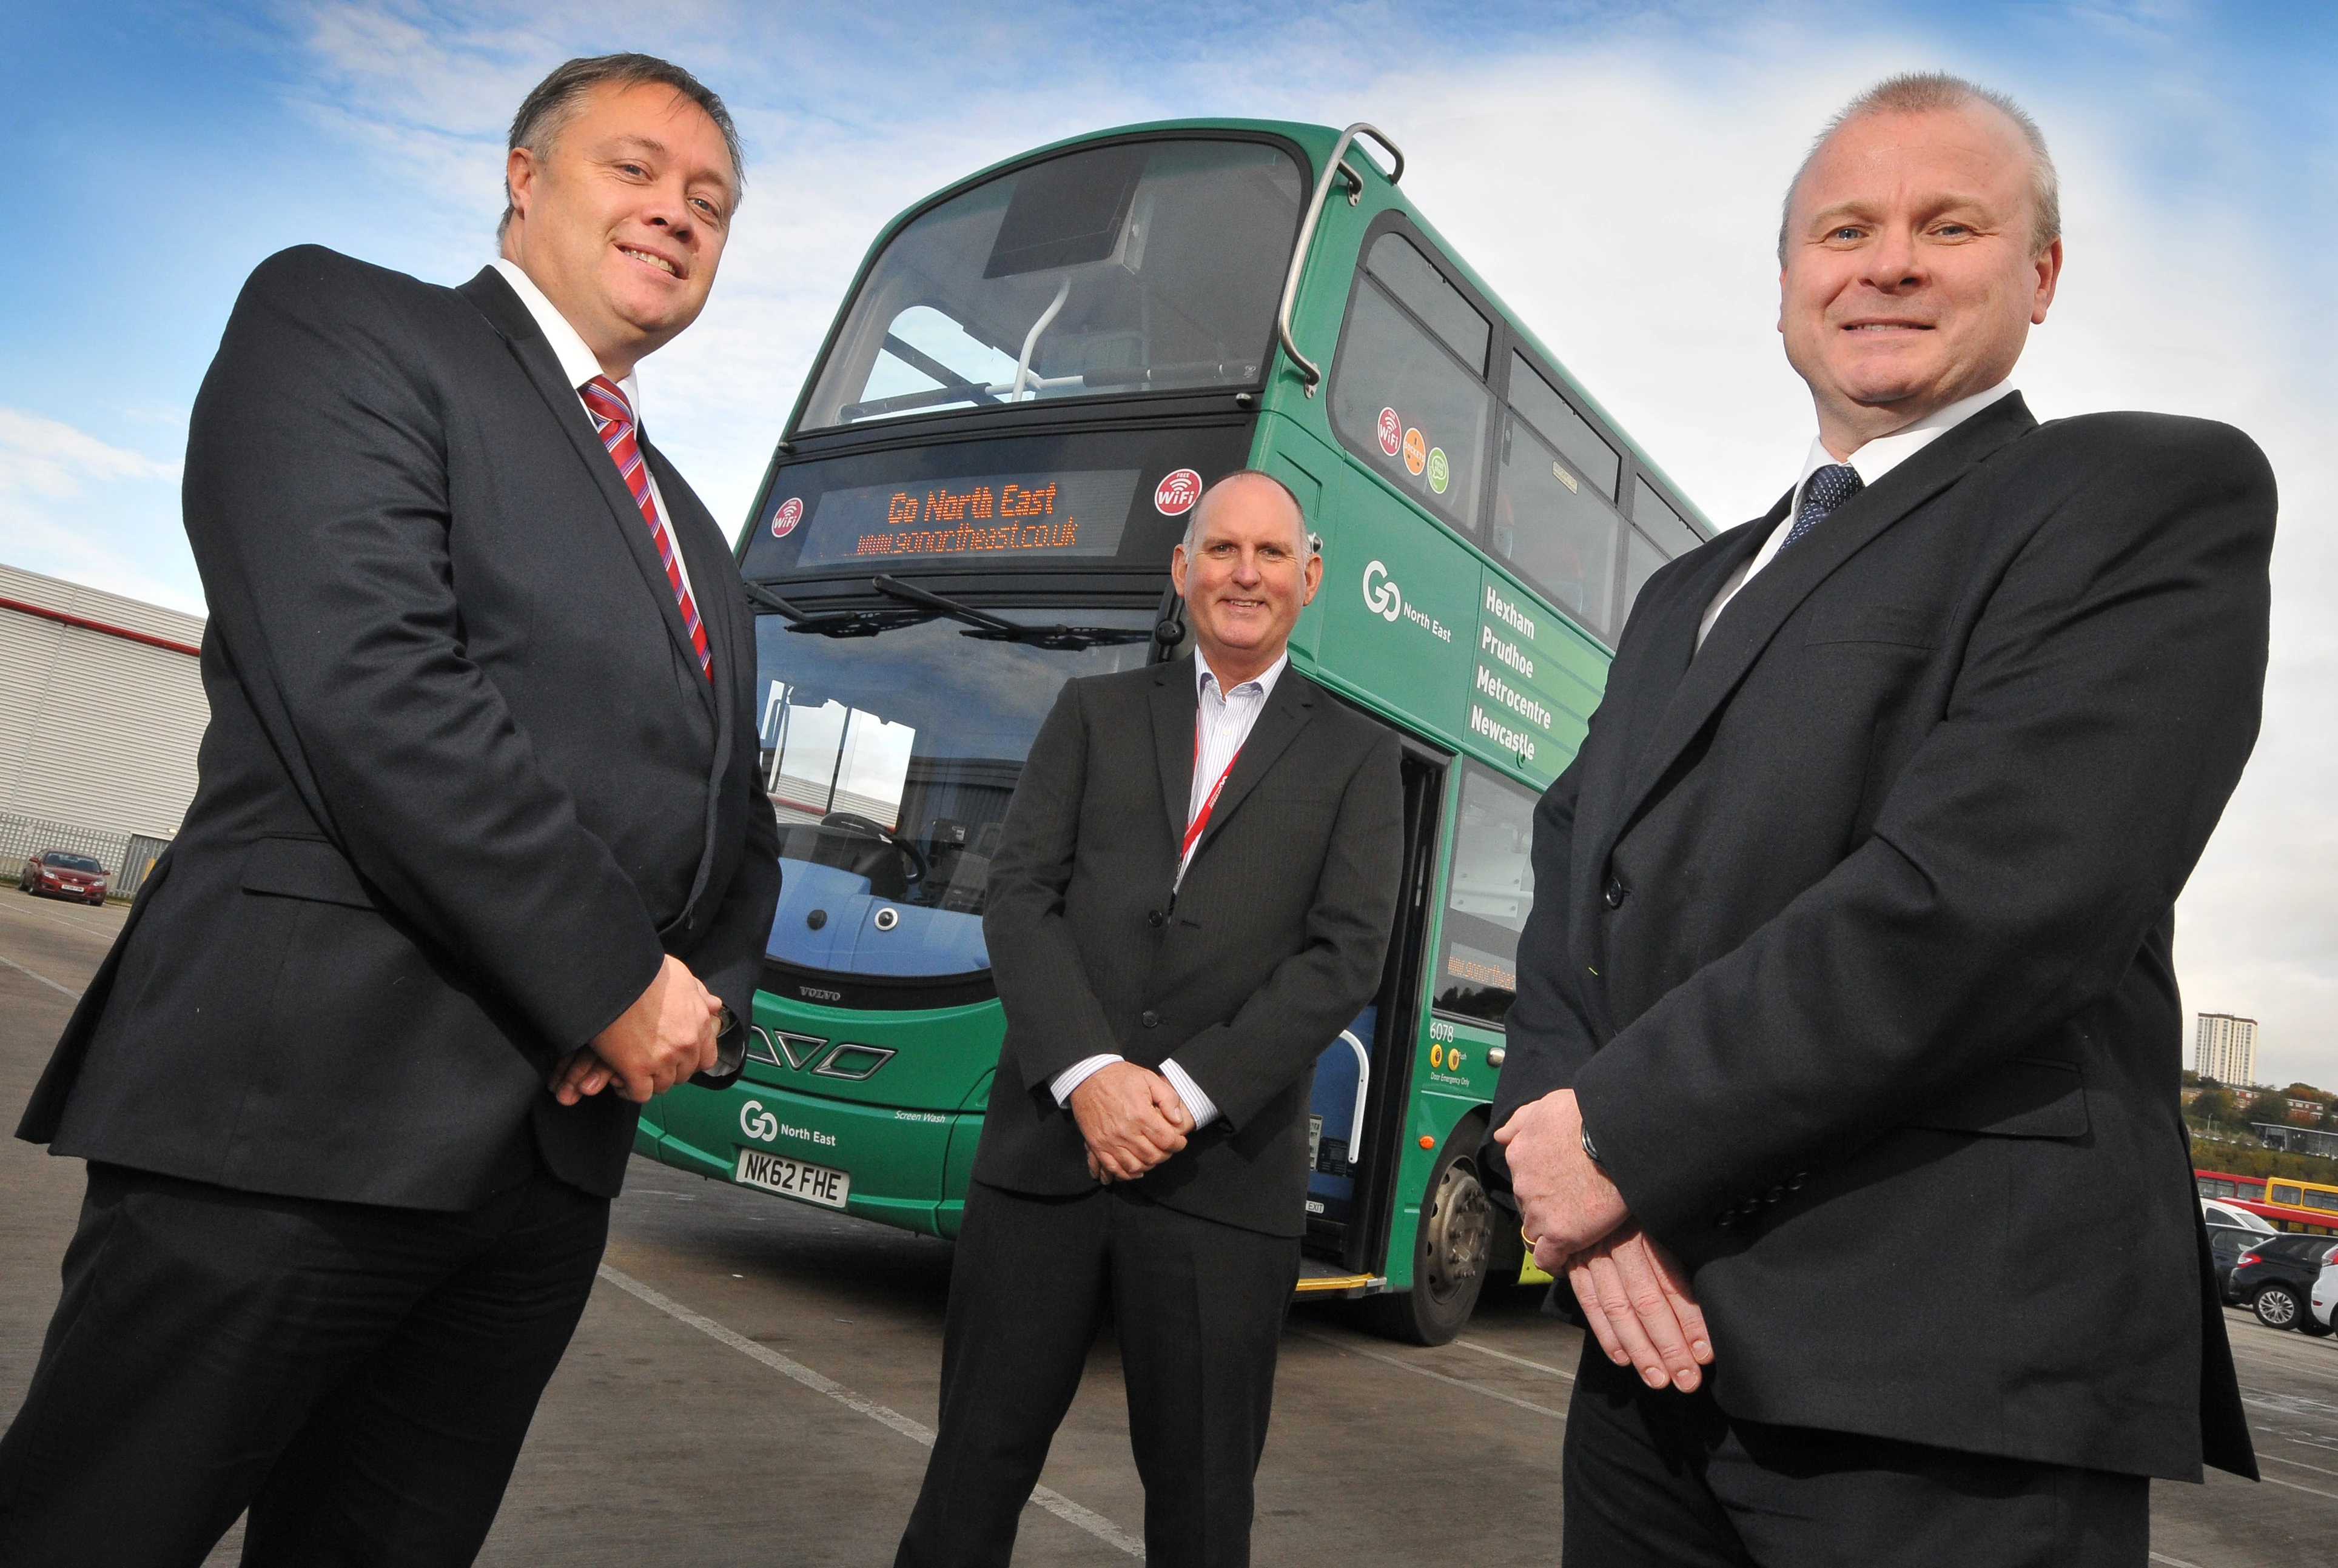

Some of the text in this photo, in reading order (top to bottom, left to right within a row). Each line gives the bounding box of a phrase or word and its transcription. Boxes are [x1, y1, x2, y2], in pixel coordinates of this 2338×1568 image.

[1380, 424, 1399, 449] WiFi
[1404, 441, 1425, 463] SOCKETS
[888, 481, 1056, 523] Go North East
[1159, 491, 1195, 504] WiFi
[774, 516, 798, 529] WiFi
[1403, 601, 1431, 630] North
[1432, 620, 1451, 643] East
[1486, 586, 1535, 640] Hexham
[1482, 625, 1534, 678] Prudhoe
[1476, 665, 1551, 729] Metrocentre
[1471, 705, 1535, 760] Newcastle
[799, 986, 841, 1001] VOLVO
[1430, 1022, 1454, 1043] 6078
[1431, 1071, 1471, 1087] Door Emergency Only
[894, 1110, 946, 1124] Screen Wash
[781, 1124, 810, 1141] North
[813, 1131, 836, 1147] East
[744, 1153, 841, 1201] NK62 FHE
[1308, 1202, 1323, 1212] EXIT
